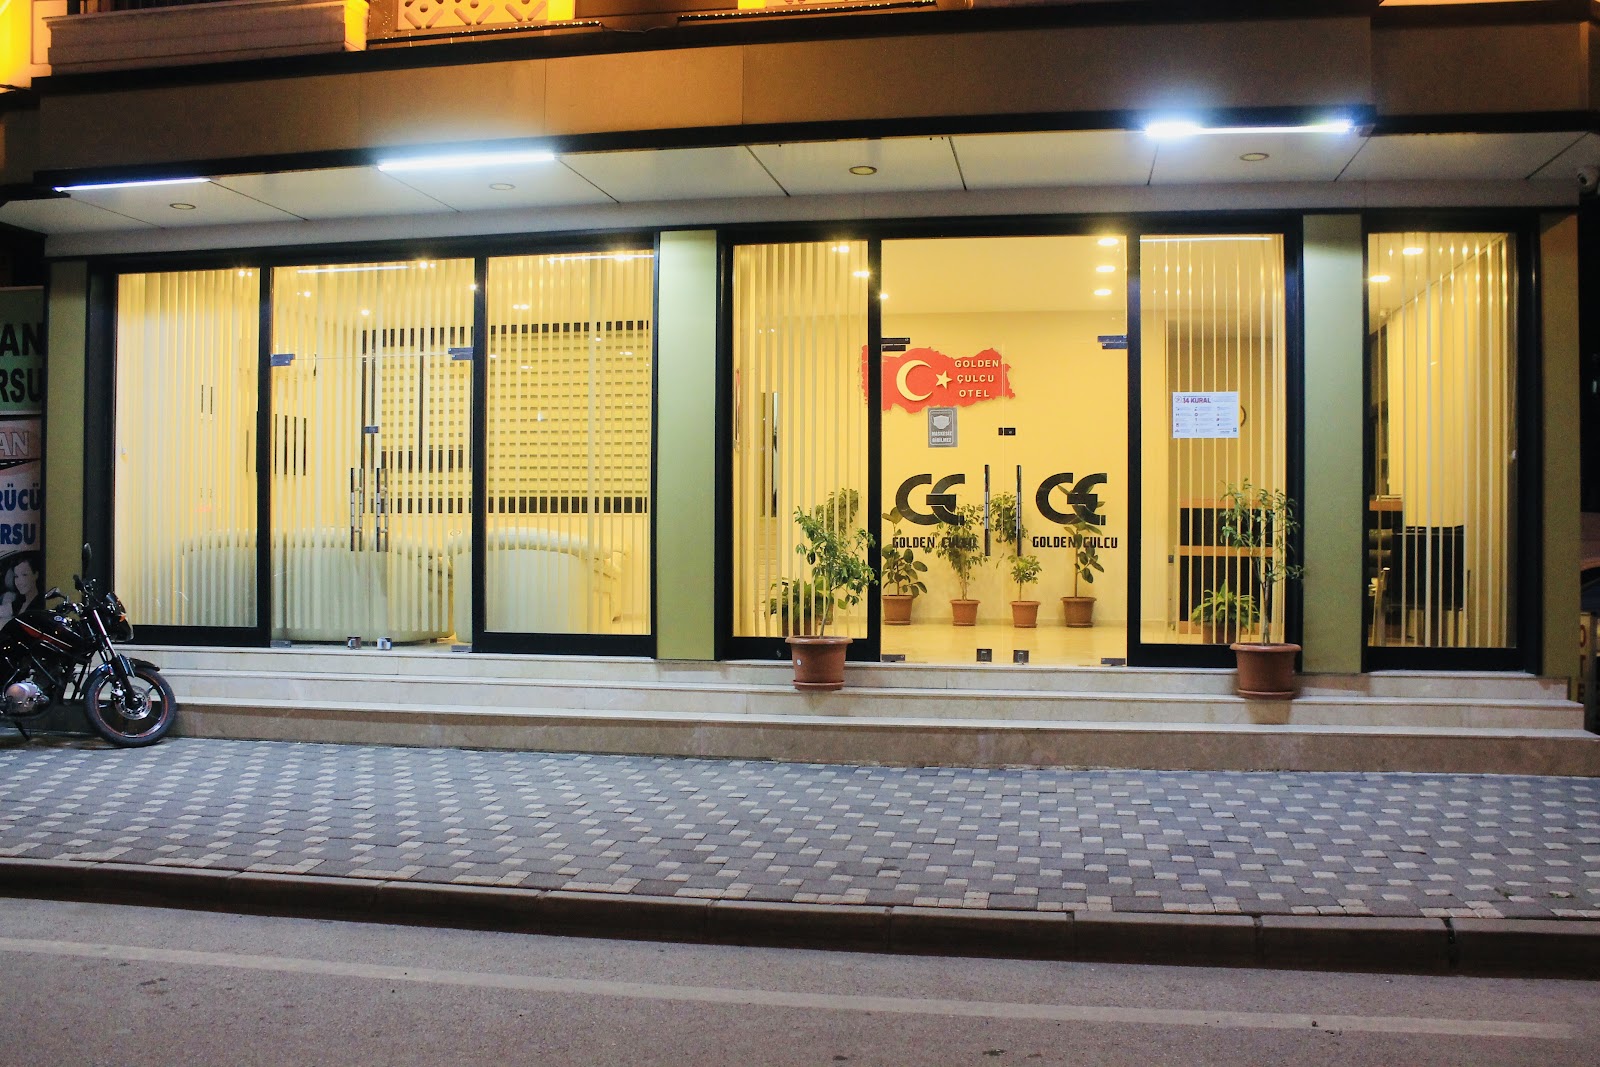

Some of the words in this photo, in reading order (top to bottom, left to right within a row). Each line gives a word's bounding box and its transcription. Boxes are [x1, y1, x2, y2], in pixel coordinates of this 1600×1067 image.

[954, 359, 999, 368] GOLDEN
[957, 374, 994, 384] ÇULCU
[959, 389, 990, 398] OTEL
[892, 536, 935, 549] GOLDEN
[1032, 536, 1076, 548] GOLDEN
